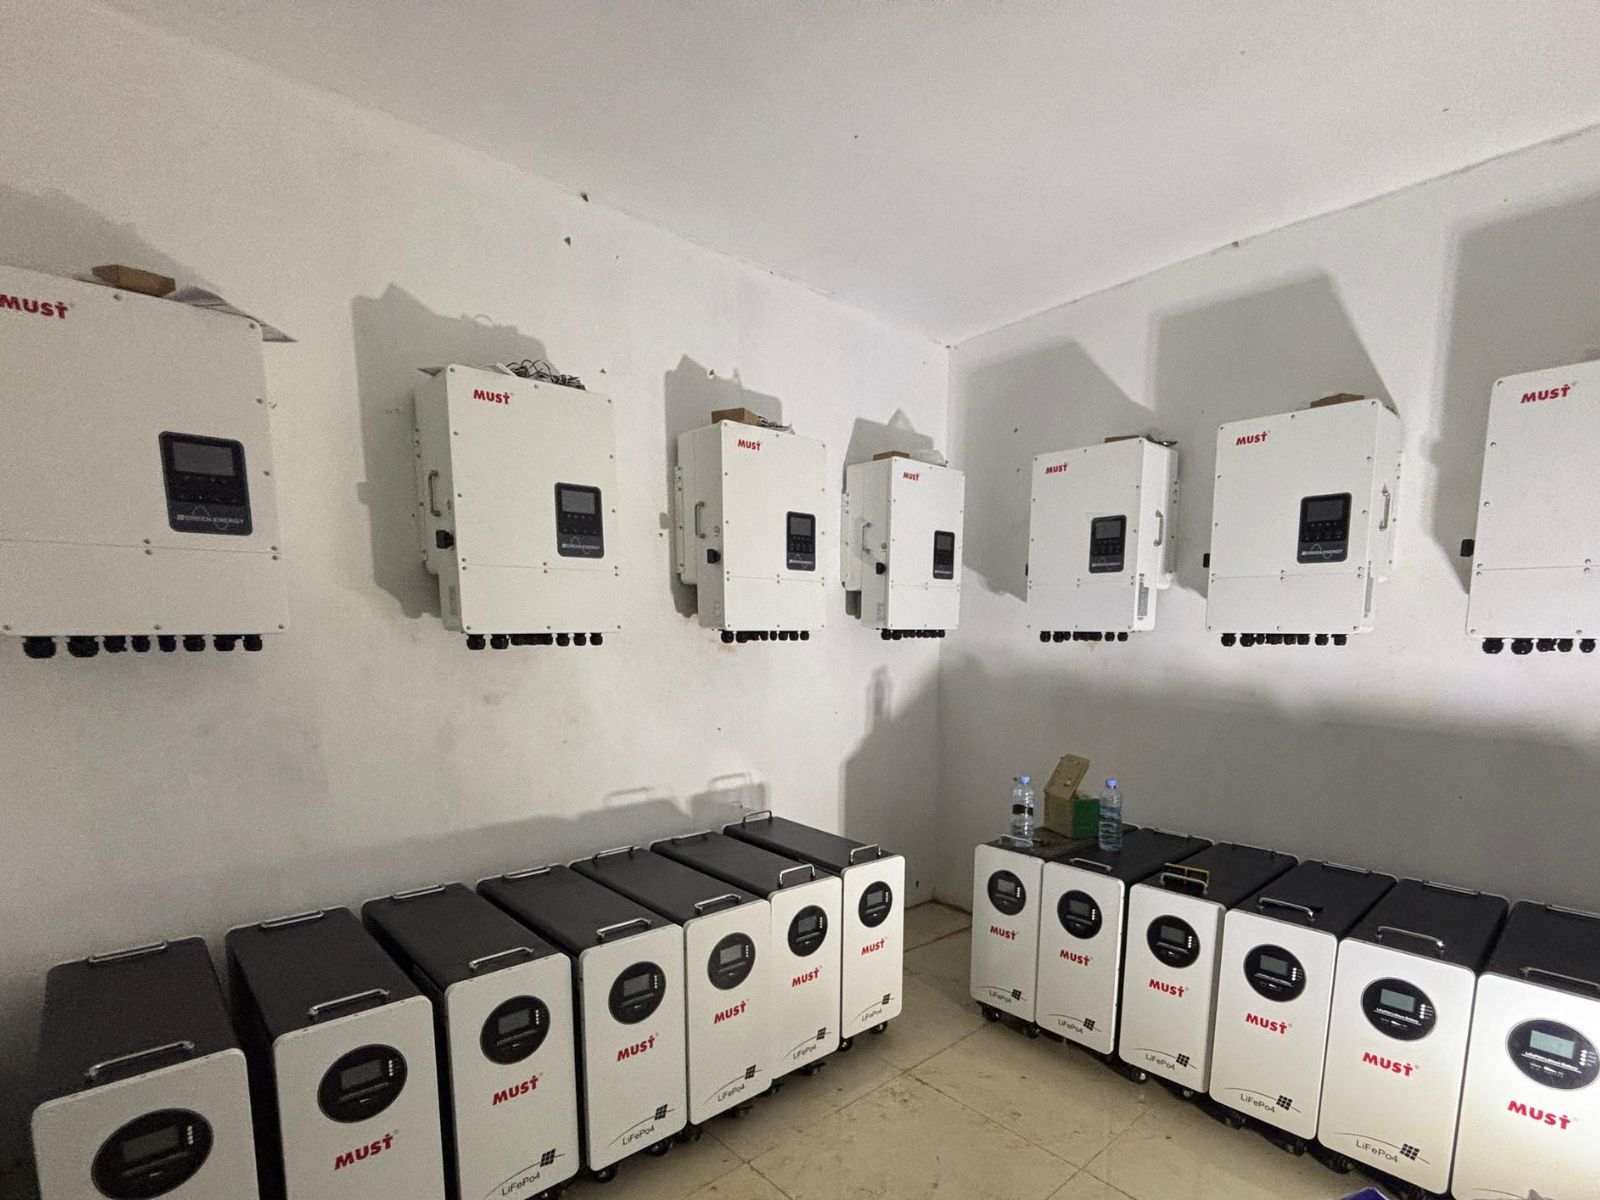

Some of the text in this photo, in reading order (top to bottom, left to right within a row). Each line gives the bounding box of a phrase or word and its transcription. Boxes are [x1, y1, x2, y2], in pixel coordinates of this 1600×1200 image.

[472, 389, 511, 405] MUST
[1521, 384, 1570, 403] MUST
[736, 439, 761, 451] MUST
[1235, 431, 1268, 446] MUST
[903, 471, 920, 482] MUST
[1045, 463, 1067, 475] MUST
[990, 925, 1016, 941] MUST
[860, 938, 886, 957] MUST
[1059, 949, 1091, 967] MUST
[791, 967, 820, 988] MUST
[1148, 978, 1185, 998] MUST
[713, 1001, 747, 1024] MUST
[1245, 1012, 1289, 1036] MUST
[616, 1035, 656, 1062] MUST
[1362, 1050, 1414, 1079] MUST
[492, 1076, 539, 1106] MUST
[1507, 1100, 1571, 1131] MUST
[335, 1134, 394, 1170] MUST
